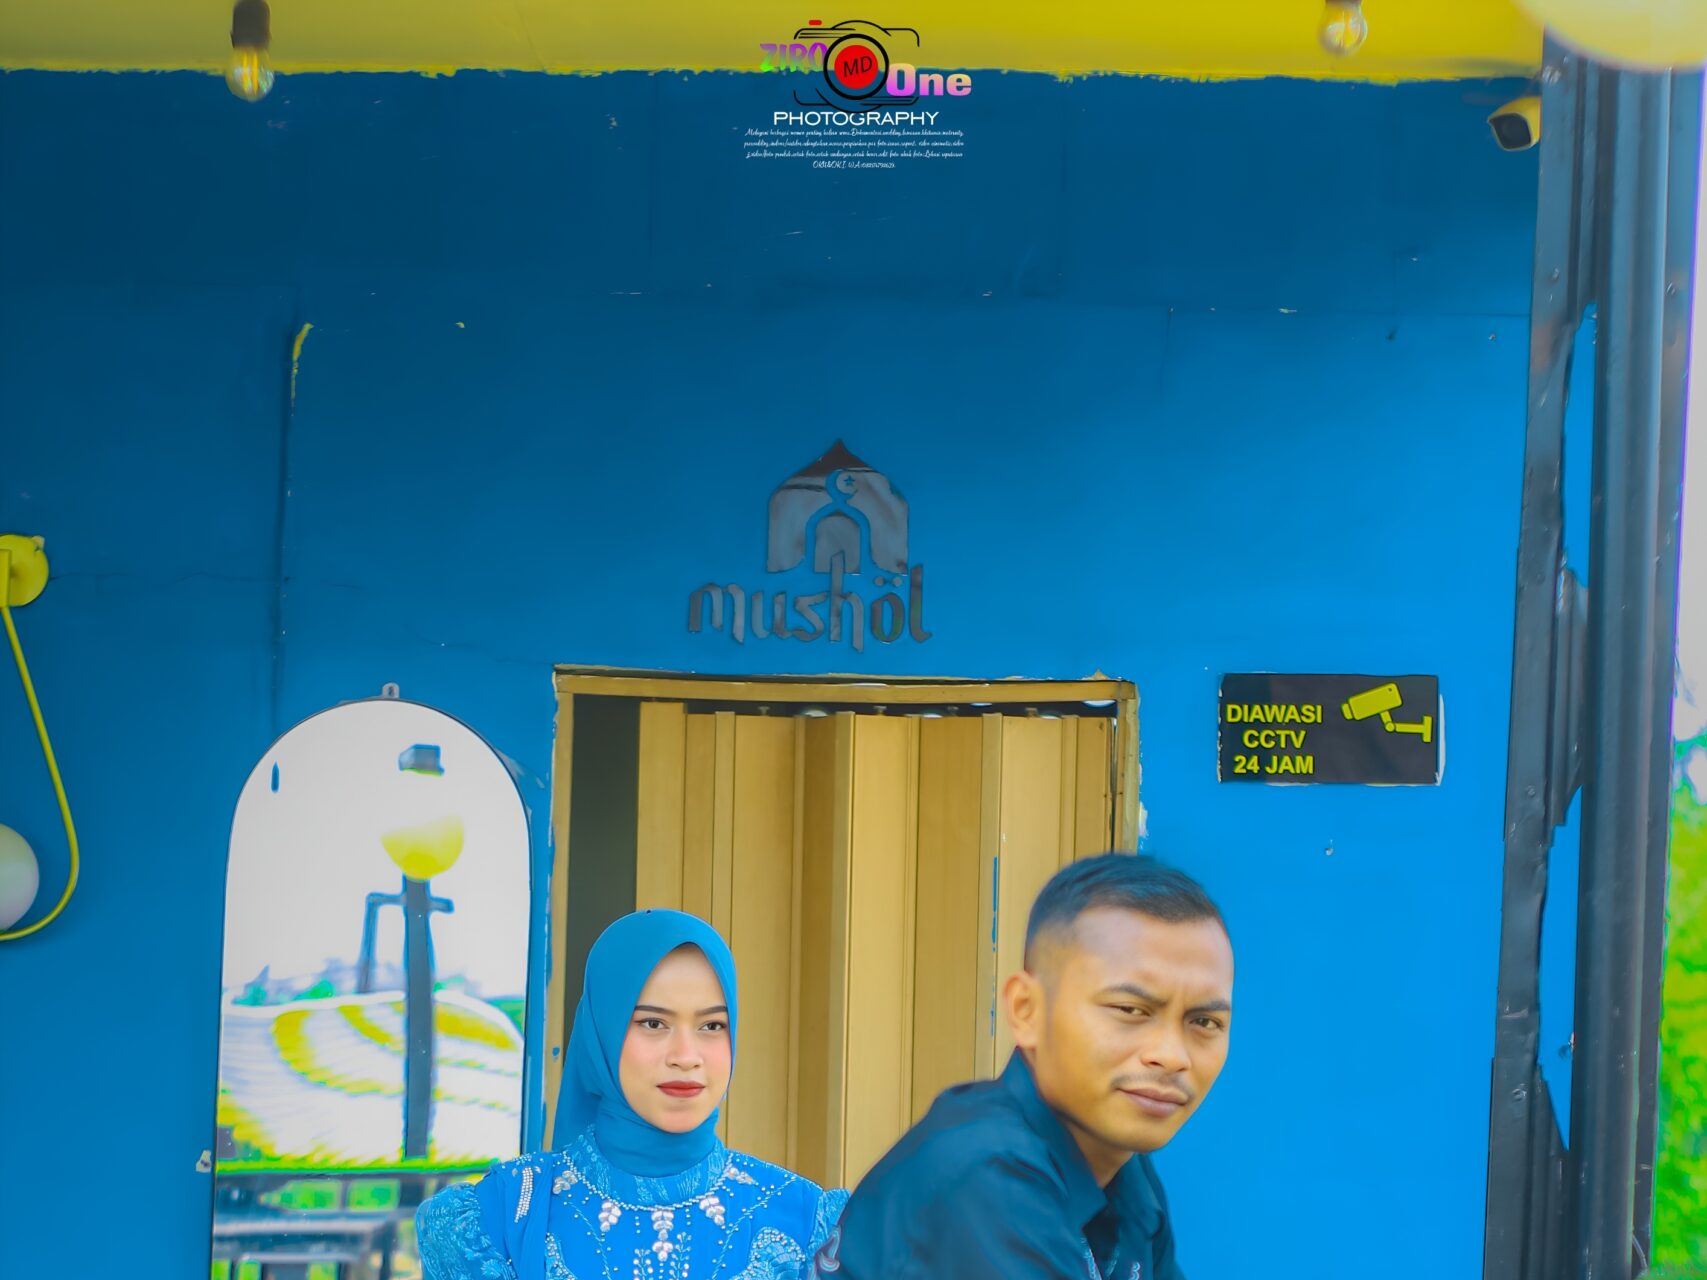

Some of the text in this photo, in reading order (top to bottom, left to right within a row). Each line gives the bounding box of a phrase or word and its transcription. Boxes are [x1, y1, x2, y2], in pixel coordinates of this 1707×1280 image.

[1225, 704, 1323, 723] DIAWASI
[1242, 729, 1306, 749] CCTV
[1233, 755, 1314, 774] 24 JAM
